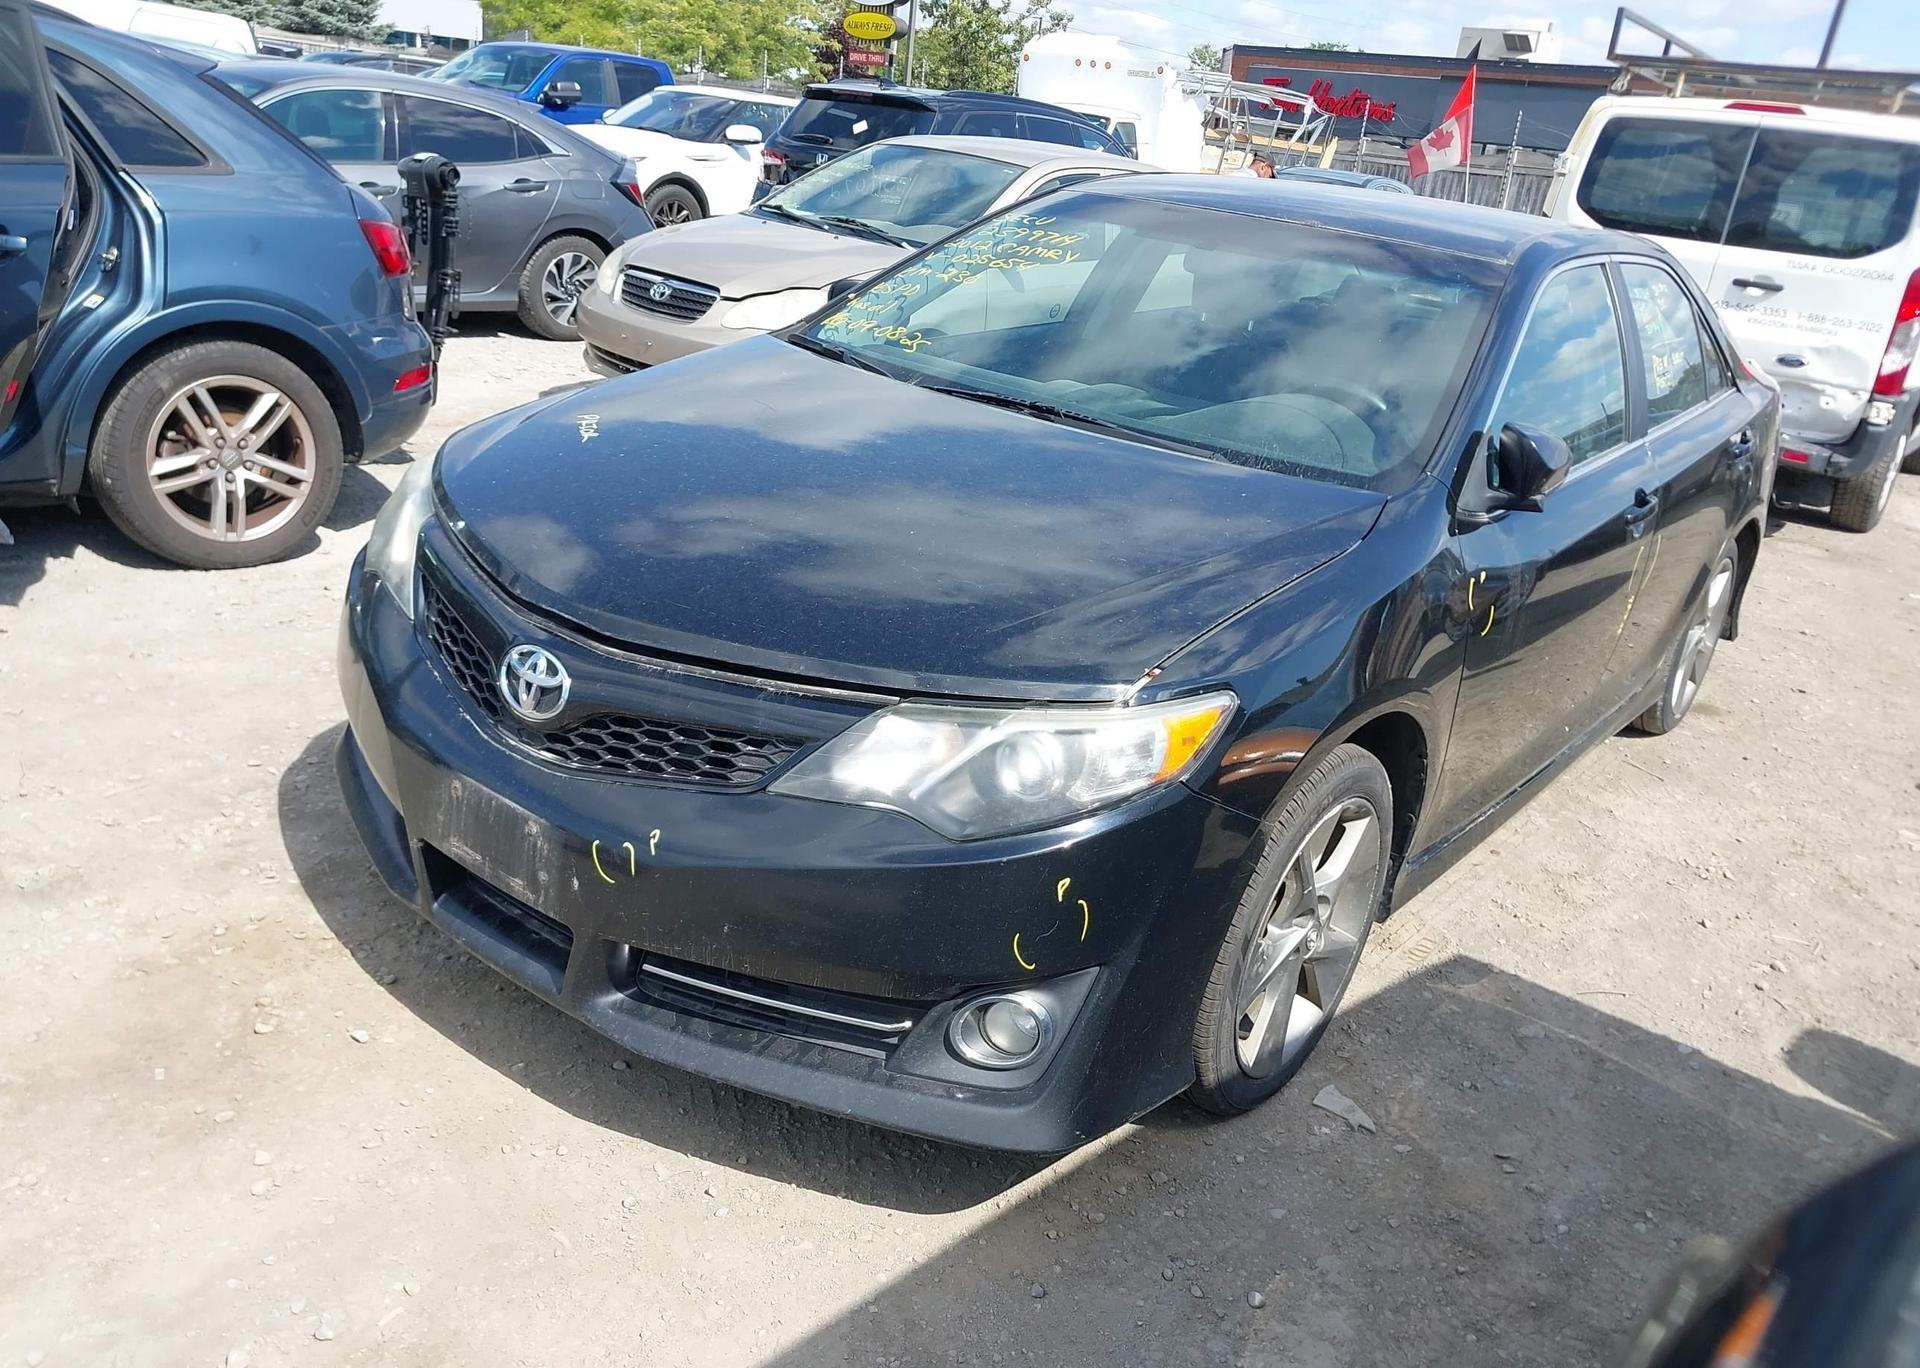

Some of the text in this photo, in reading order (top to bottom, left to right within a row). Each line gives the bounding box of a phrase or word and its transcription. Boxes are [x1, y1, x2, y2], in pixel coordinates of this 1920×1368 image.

[847, 20, 892, 32] ALWAYS FRESH
[849, 52, 884, 64] DRIVE THRU
[943, 238, 1081, 265] 2012 CAMRY
